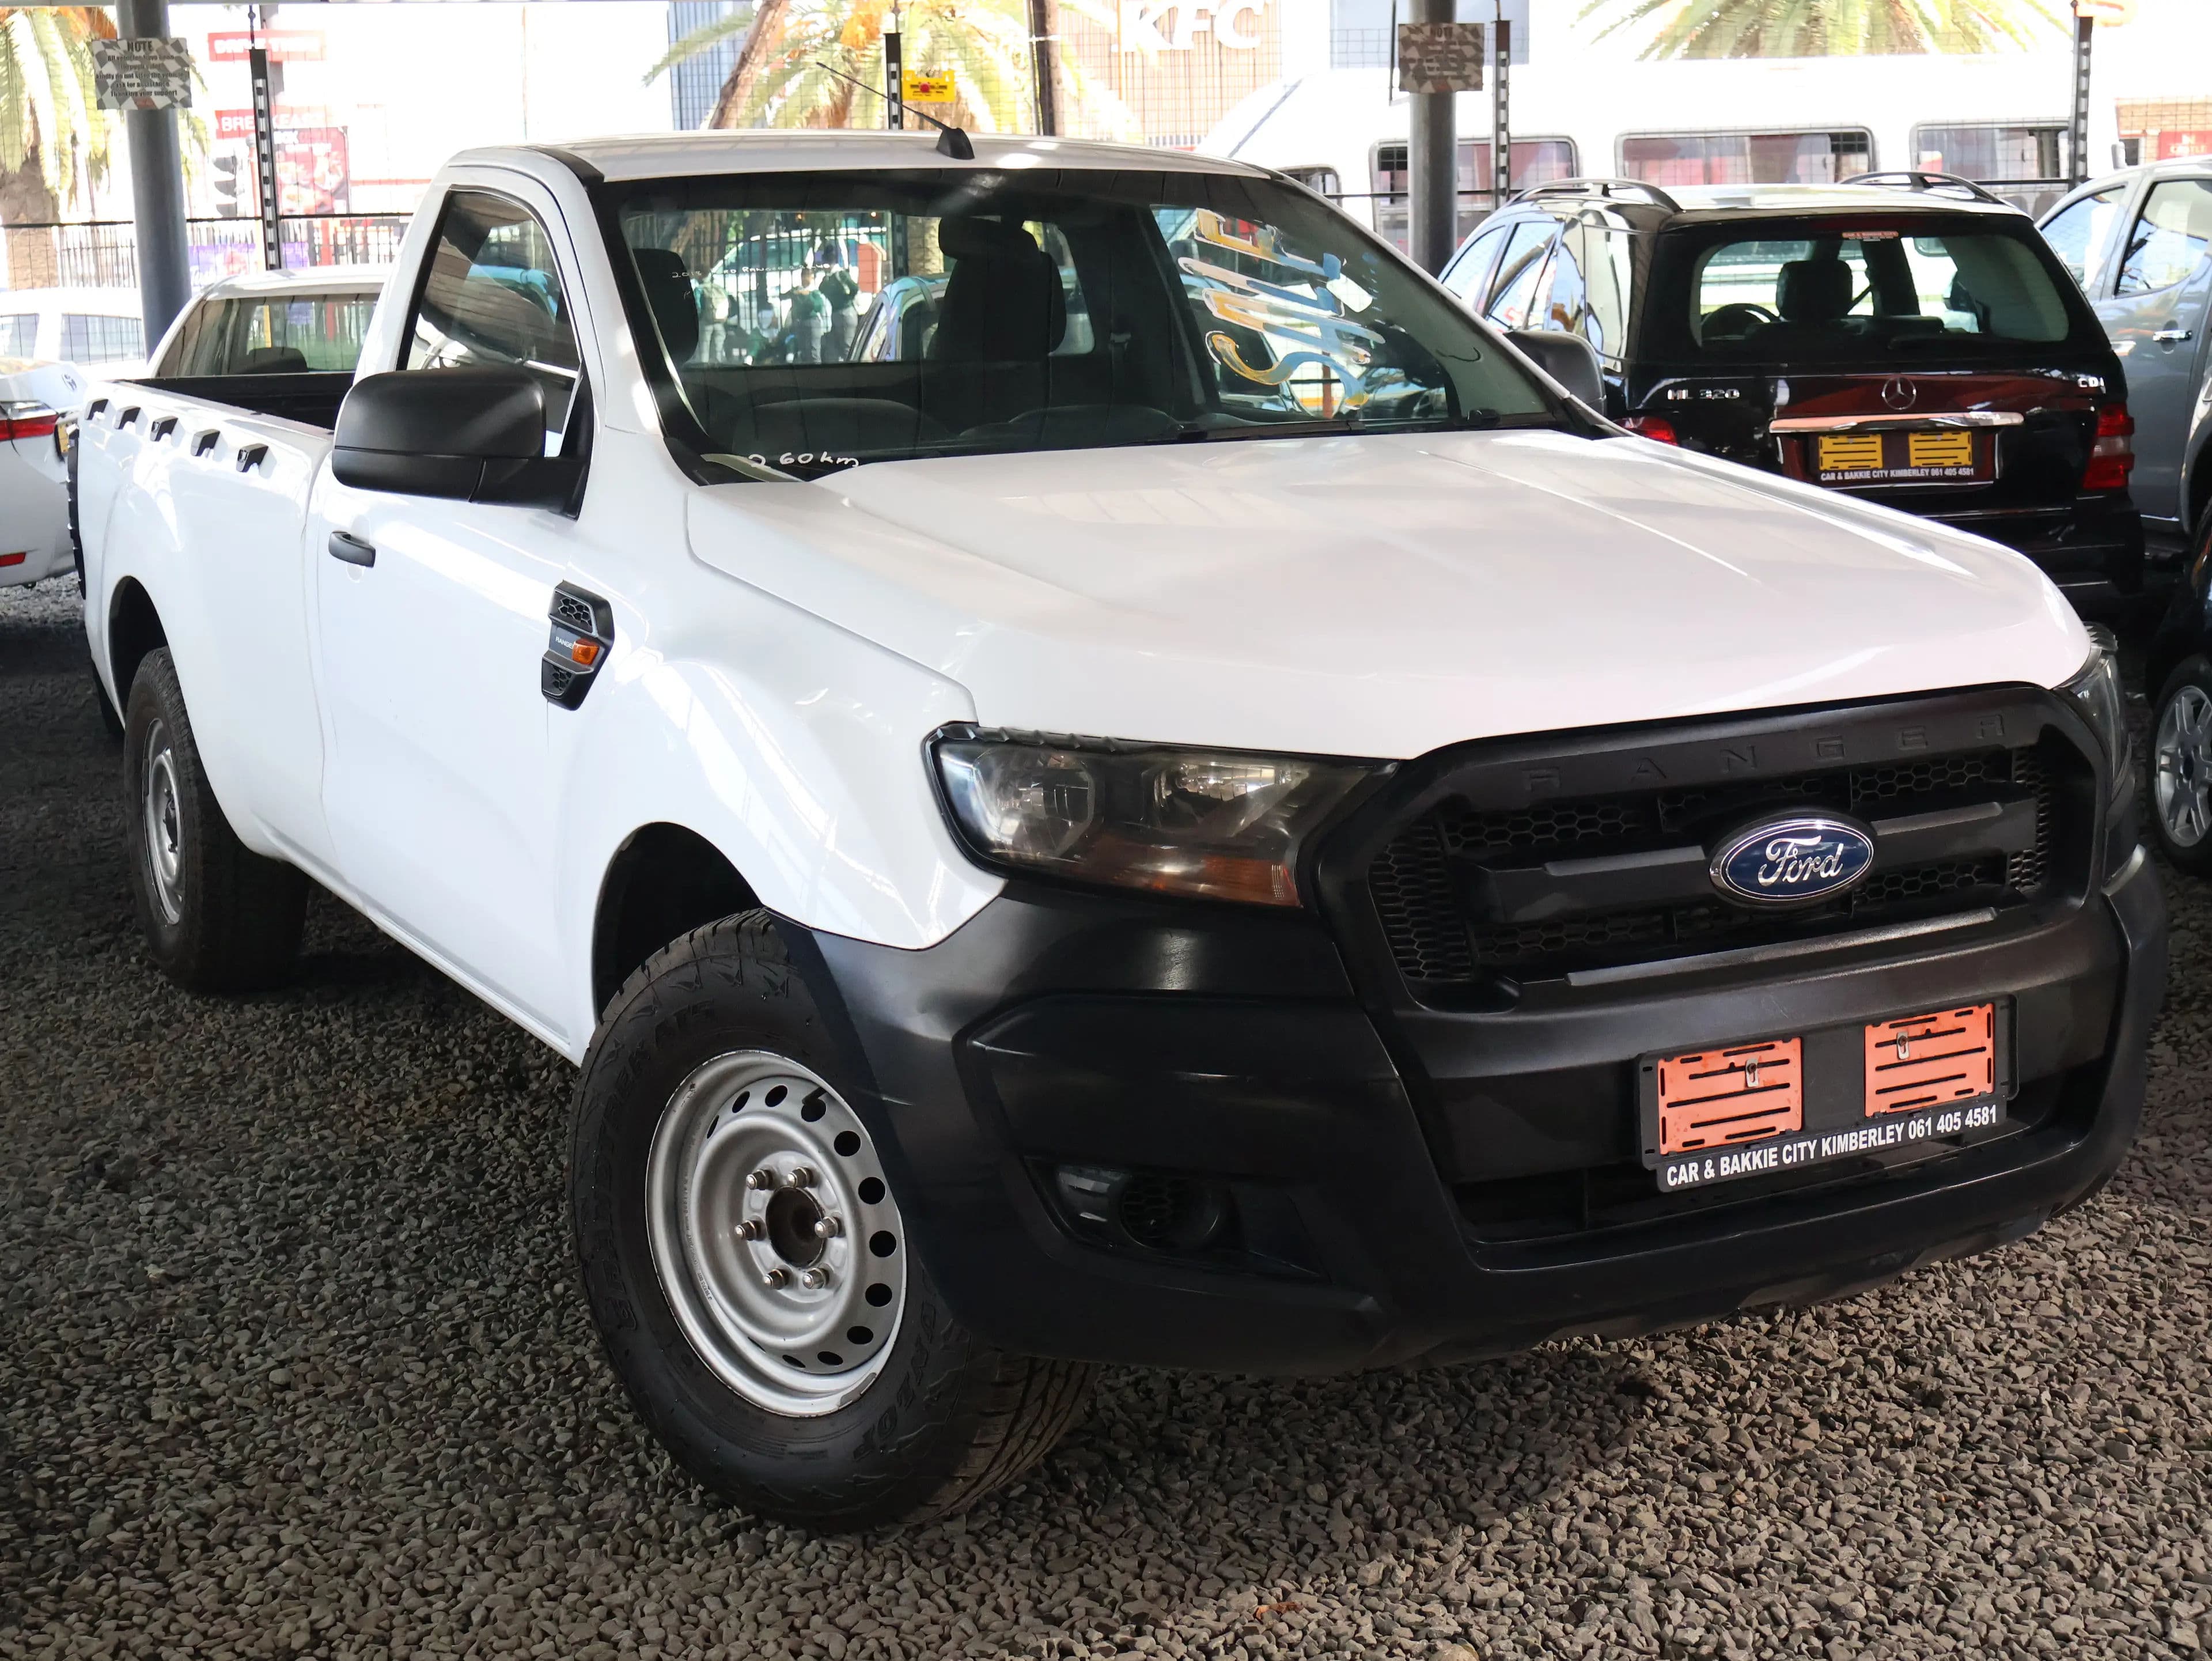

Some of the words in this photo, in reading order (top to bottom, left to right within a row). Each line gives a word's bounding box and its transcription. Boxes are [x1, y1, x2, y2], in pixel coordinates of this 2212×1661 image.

[1111, 0, 1263, 53] KFC
[128, 41, 153, 51] NOTE
[154, 89, 177, 97] support
[1668, 389, 1693, 400] ML
[1821, 472, 1836, 482] CAR
[1836, 472, 1843, 480] &
[1844, 470, 1871, 480] BAKKIE
[1872, 470, 1889, 478] CITY
[1890, 468, 1930, 478] KIMBERLEY
[555, 636, 577, 649] RANGE
[1524, 714, 2005, 792] RANGER
[1758, 835, 1844, 887] Ford
[1667, 1161, 1699, 1187] CAR
[1703, 1159, 1715, 1179] &
[1720, 1147, 1778, 1176] BAKKIE
[1782, 1139, 1817, 1164] CITY
[1821, 1121, 1905, 1157] KIMBERLEY
[1908, 1117, 1931, 1140] 061
[1936, 1111, 1961, 1134] 405
[1964, 1104, 1997, 1128] 4581
